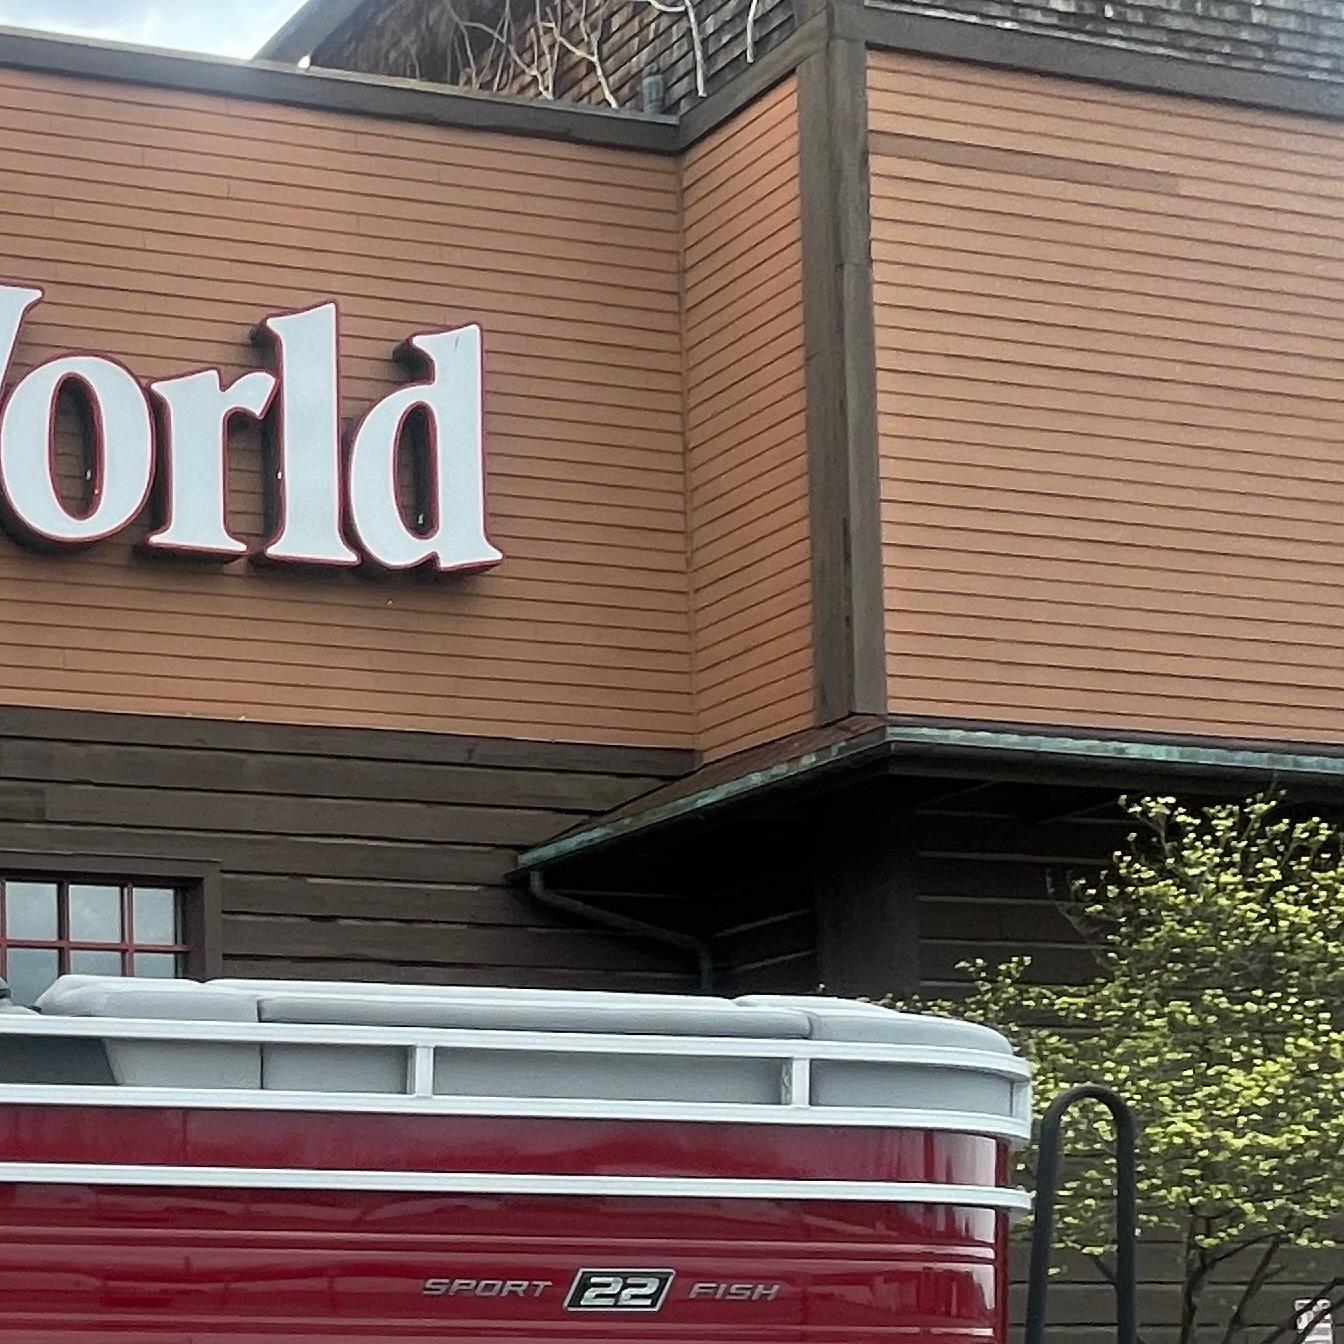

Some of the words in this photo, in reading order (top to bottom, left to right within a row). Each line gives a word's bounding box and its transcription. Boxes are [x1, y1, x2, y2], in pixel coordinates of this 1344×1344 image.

[422, 1277, 553, 1298] SPORT
[579, 1276, 661, 1307] 22
[688, 1281, 783, 1302] FISH
